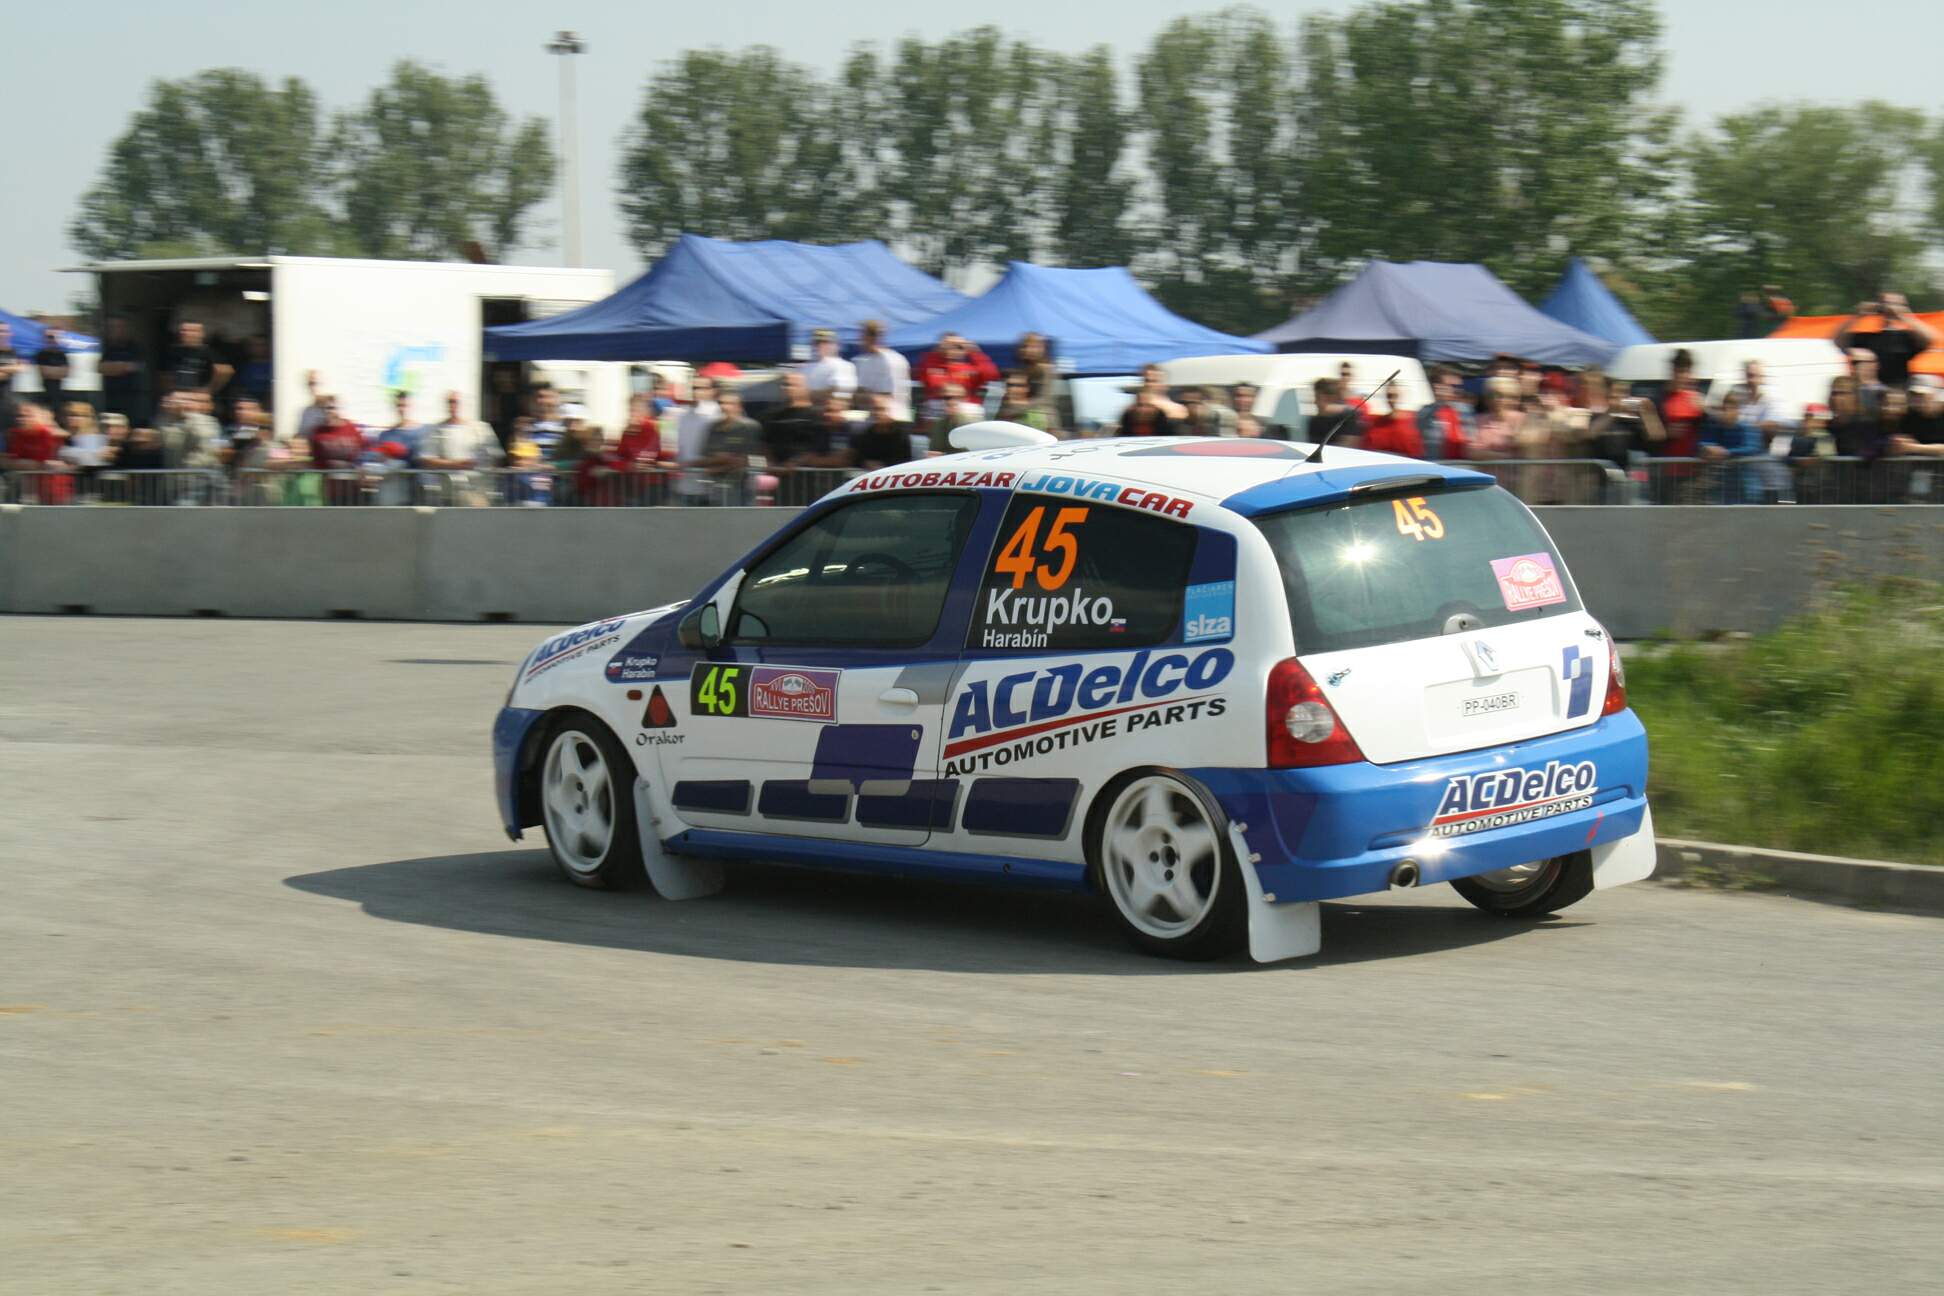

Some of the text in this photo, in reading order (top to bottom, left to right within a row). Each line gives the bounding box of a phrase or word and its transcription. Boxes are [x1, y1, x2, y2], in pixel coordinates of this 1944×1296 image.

[849, 472, 1016, 492] AUTOBAZAR
[1391, 496, 1445, 541] 45
[994, 505, 1090, 591] 45
[985, 587, 1114, 634] Krupko
[1186, 613, 1231, 637] slza
[982, 628, 1048, 648] Harabín
[698, 666, 739, 716] 45
[756, 686, 790, 711] RALLYE
[948, 647, 1236, 740] ACDelco
[635, 730, 686, 746] Orakor
[944, 698, 1227, 779] AUTOMOTIVE PARTS
[1439, 760, 1595, 816] ACDelco
[1432, 794, 1591, 838] AUTOMOTIVE PARTS
